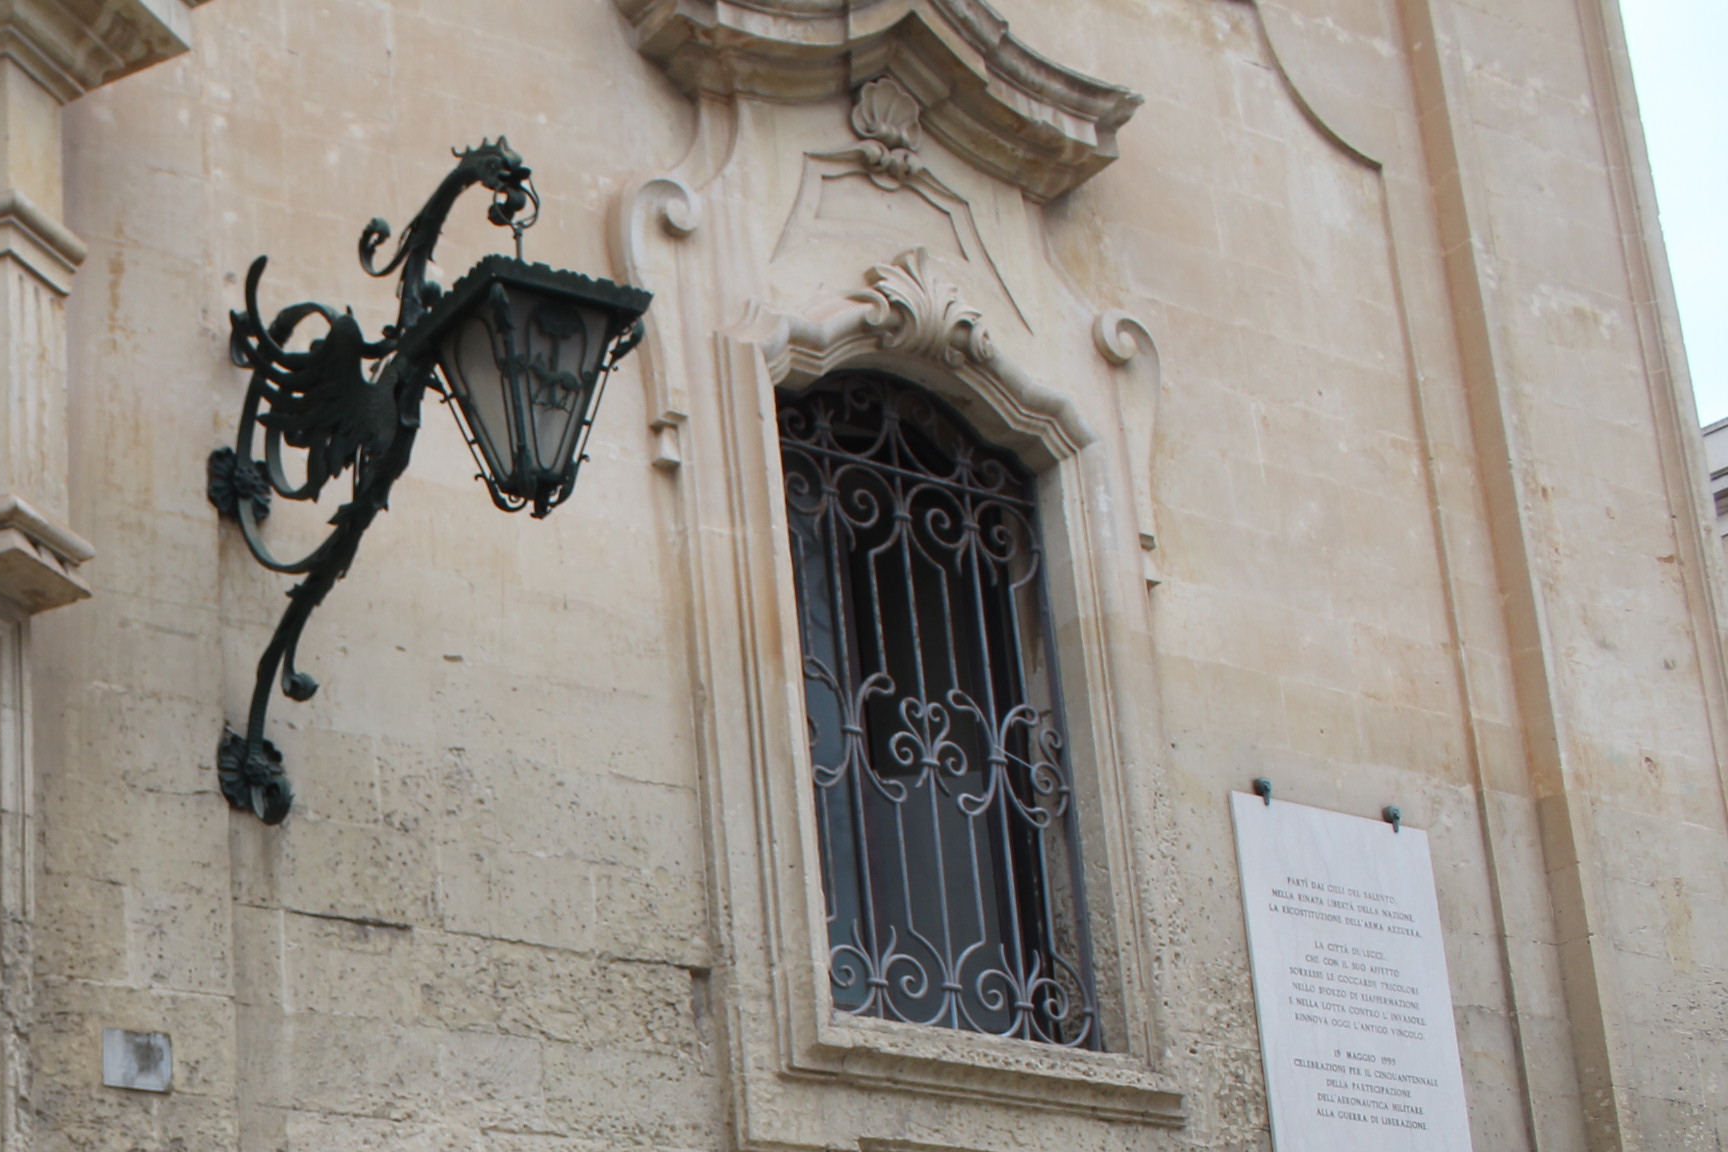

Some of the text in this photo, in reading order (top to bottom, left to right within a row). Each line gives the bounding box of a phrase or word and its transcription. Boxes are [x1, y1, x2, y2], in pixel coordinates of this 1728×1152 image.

[1311, 882, 1324, 891] DAI
[1348, 888, 1360, 898] DEL
[1272, 889, 1294, 899] NELLA
[1298, 894, 1323, 905] RINATA
[1358, 905, 1379, 915] DELLA
[1269, 903, 1278, 912] LA
[1282, 906, 1342, 923] RICOSTITUZIONE
[1315, 941, 1324, 950] LA
[1305, 955, 1318, 963] CHE
[1323, 958, 1338, 966] CON
[1352, 963, 1366, 971] SUO
[1370, 966, 1399, 977] AFFETTO
[1290, 967, 1419, 995] SORRESSE LE COCCARDE TRICOLORI
[1292, 982, 1419, 1010] NELLO SFORZO DI RIAFFERMAZIONE
[1296, 998, 1319, 1009] NELLA
[1322, 1002, 1346, 1012] LOTTA
[1349, 1007, 1380, 1018] CONTRO
[1295, 1012, 1328, 1025] RINNOVA
[1332, 1019, 1351, 1029] OGGI
[1346, 1051, 1375, 1063] MAGGIO
[1294, 1058, 1439, 1087] CELEBRAZIONI PER IL CINQUANTENNALE
[1326, 1079, 1411, 1098] DELLA PARTECIPAZIONE
[1317, 1108, 1334, 1118] ALLA
[1338, 1111, 1367, 1122] GUERRA
[1371, 1116, 1378, 1124] DI
[1393, 1104, 1423, 1115] MILITARE
